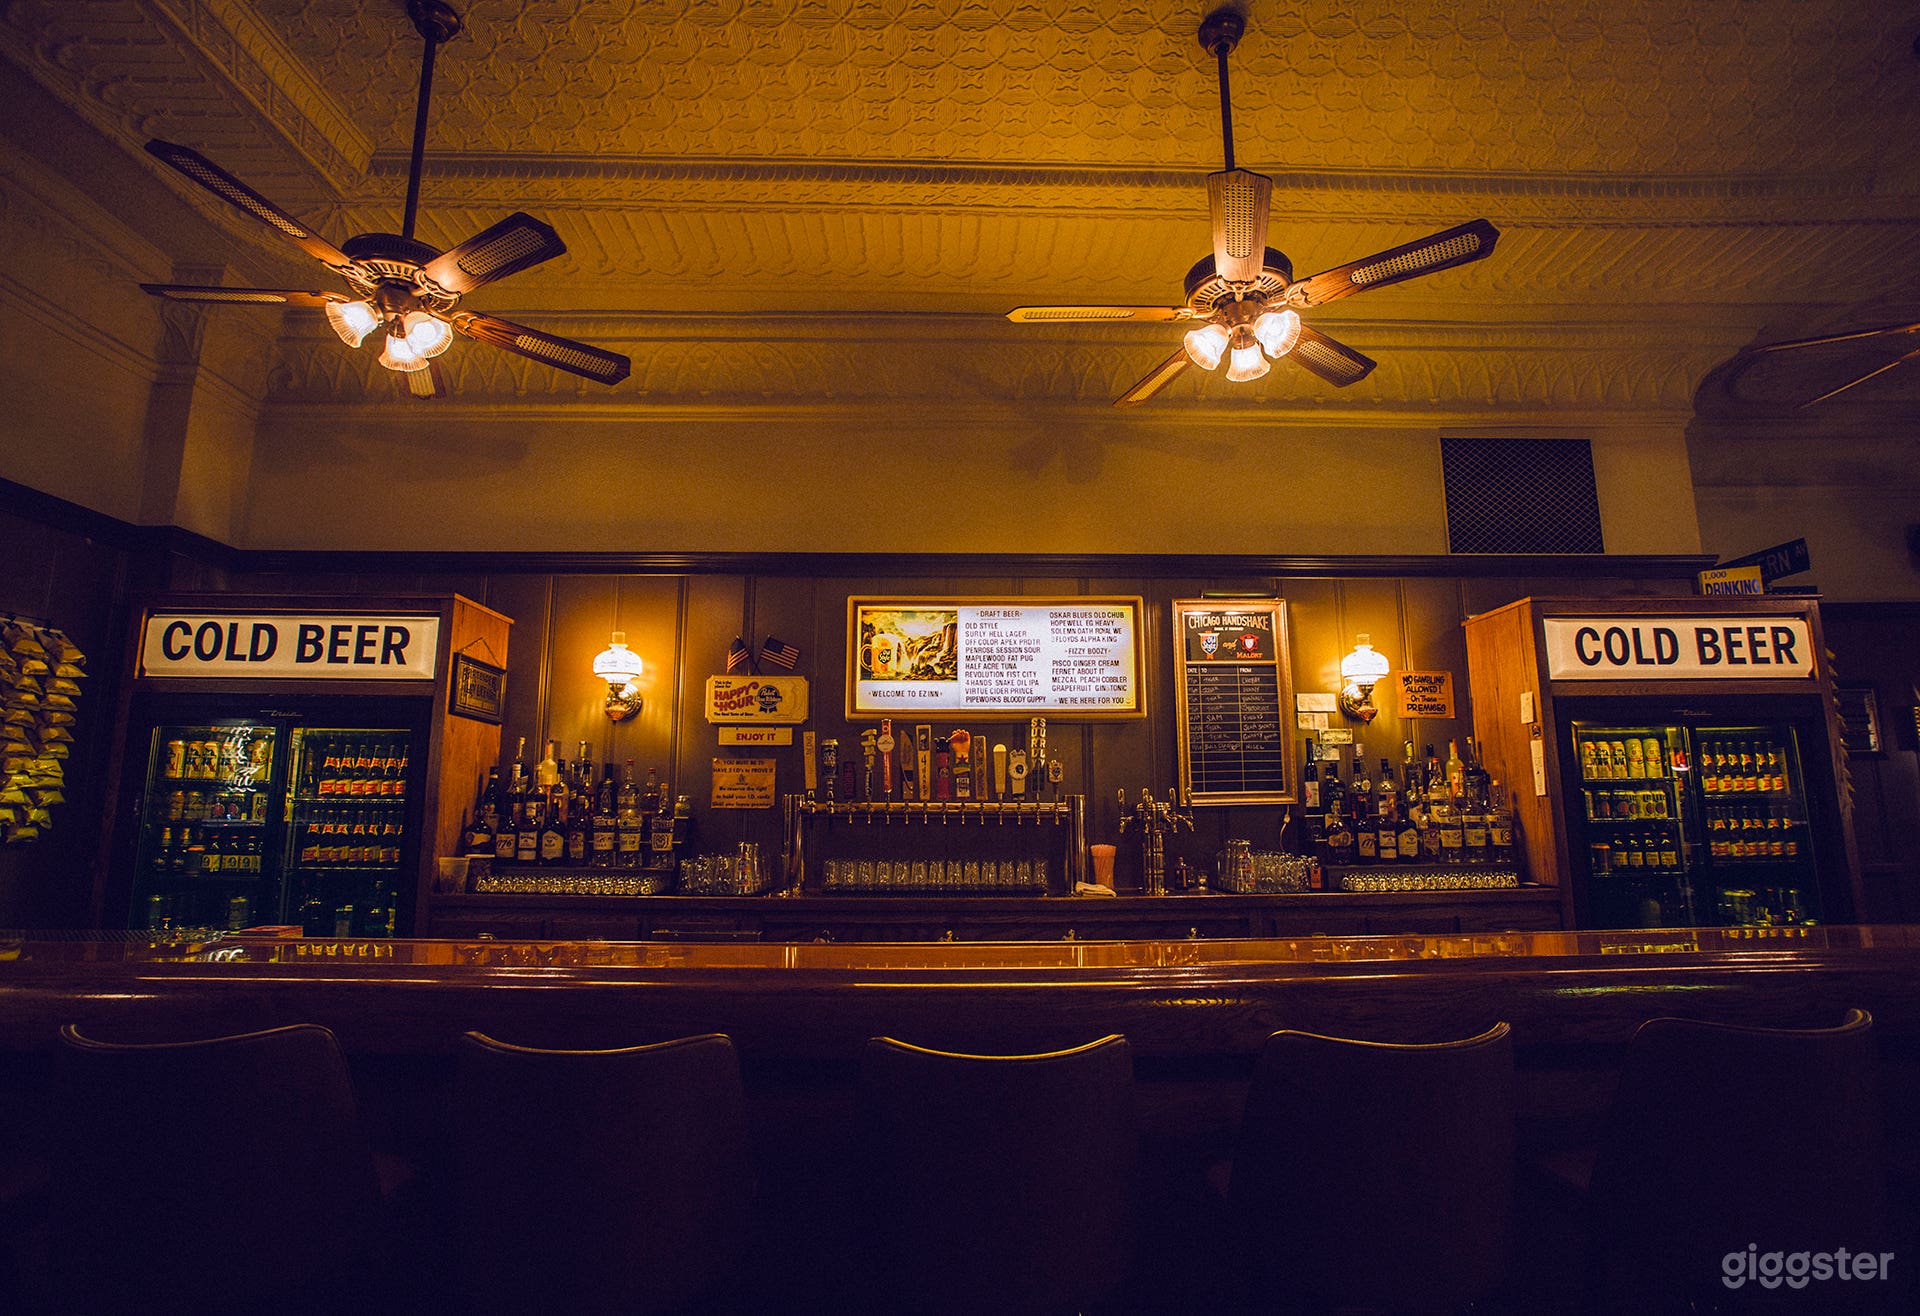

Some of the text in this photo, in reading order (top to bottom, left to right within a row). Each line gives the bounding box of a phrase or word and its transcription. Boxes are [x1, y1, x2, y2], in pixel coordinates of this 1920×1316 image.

[1703, 571, 1727, 580] 1,000
[1705, 578, 1760, 595] DRINKING
[1188, 615, 1270, 631] CHICAGO HANDSHAKE
[162, 621, 411, 665] COLD BEER
[1575, 626, 1799, 666] COLD BEER
[1402, 675, 1445, 684] NO GAMBLING
[714, 681, 759, 700] HAPPY
[872, 690, 905, 698] WELCOME
[908, 690, 916, 698] TO
[714, 695, 754, 711] HOUR
[1407, 704, 1446, 712] PREMISES
[1206, 714, 1223, 722] SAM
[1030, 717, 1038, 768] SURLY
[1039, 717, 1047, 768] SURLY
